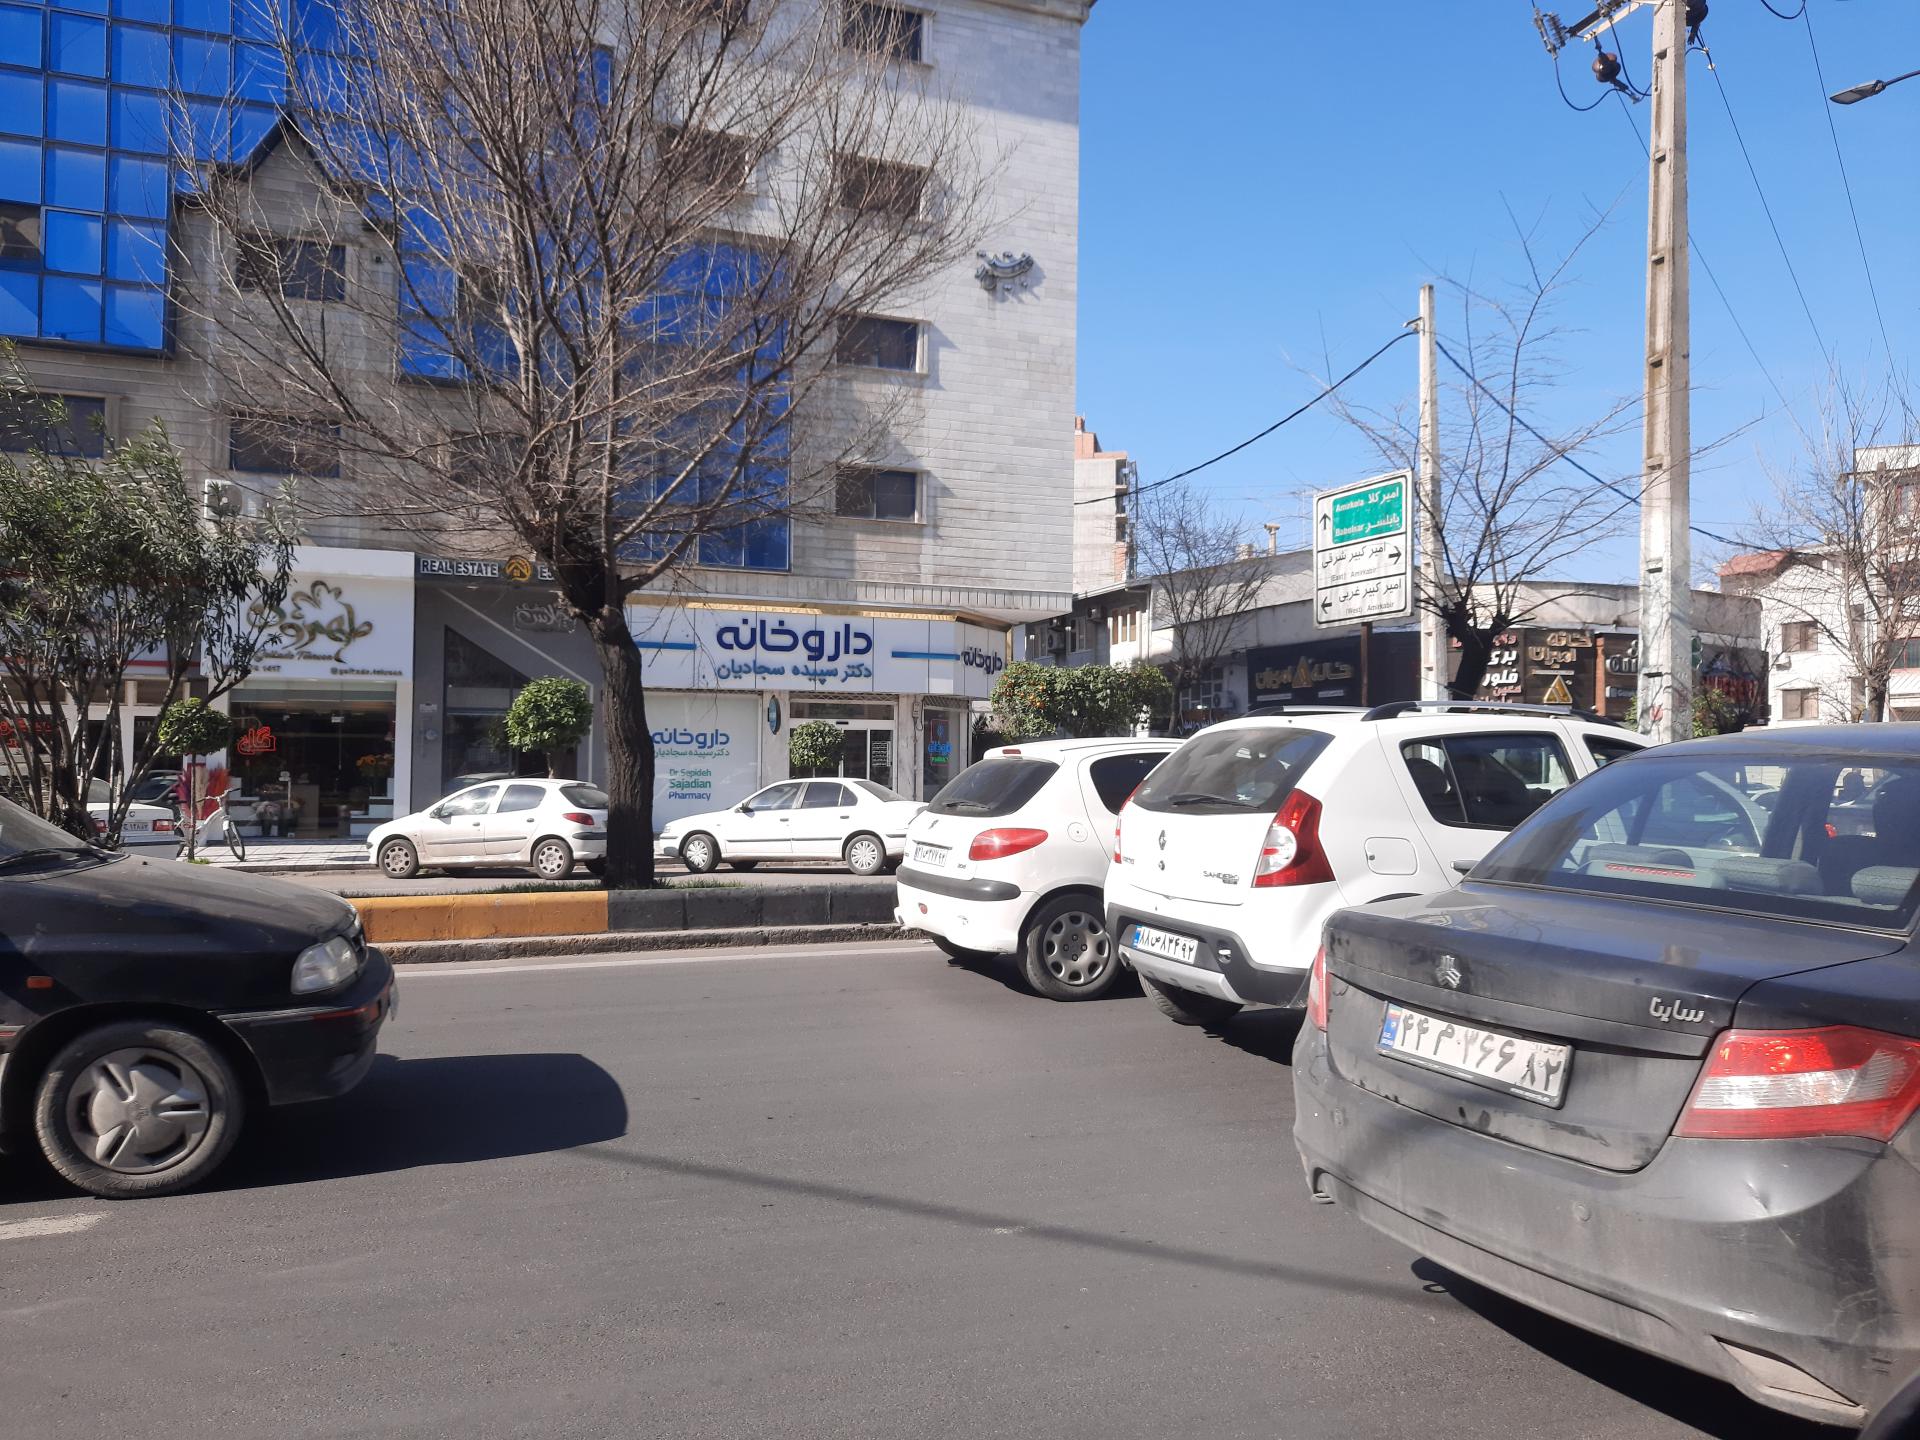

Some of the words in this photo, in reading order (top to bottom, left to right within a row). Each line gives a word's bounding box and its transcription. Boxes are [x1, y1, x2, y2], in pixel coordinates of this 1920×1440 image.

[1349, 545, 1366, 562] کبیر
[1368, 542, 1386, 559] امیر
[420, 558, 452, 574] REAL
[454, 561, 499, 577] ESTATE
[1322, 552, 1347, 568] شرقی
[1362, 582, 1381, 599] کبیر
[1384, 579, 1402, 594] امیر
[716, 618, 873, 662] داروخانه
[961, 646, 1003, 675] داروخانه
[717, 659, 785, 680] سجادیان
[791, 665, 839, 686] سپیده
[840, 663, 872, 683] دکتر
[652, 728, 730, 750] داروخانه
[669, 768, 679, 776] Dr
[681, 768, 711, 778] Sepideh
[669, 779, 711, 790] Sajadian
[668, 790, 711, 801] Pharmacy
